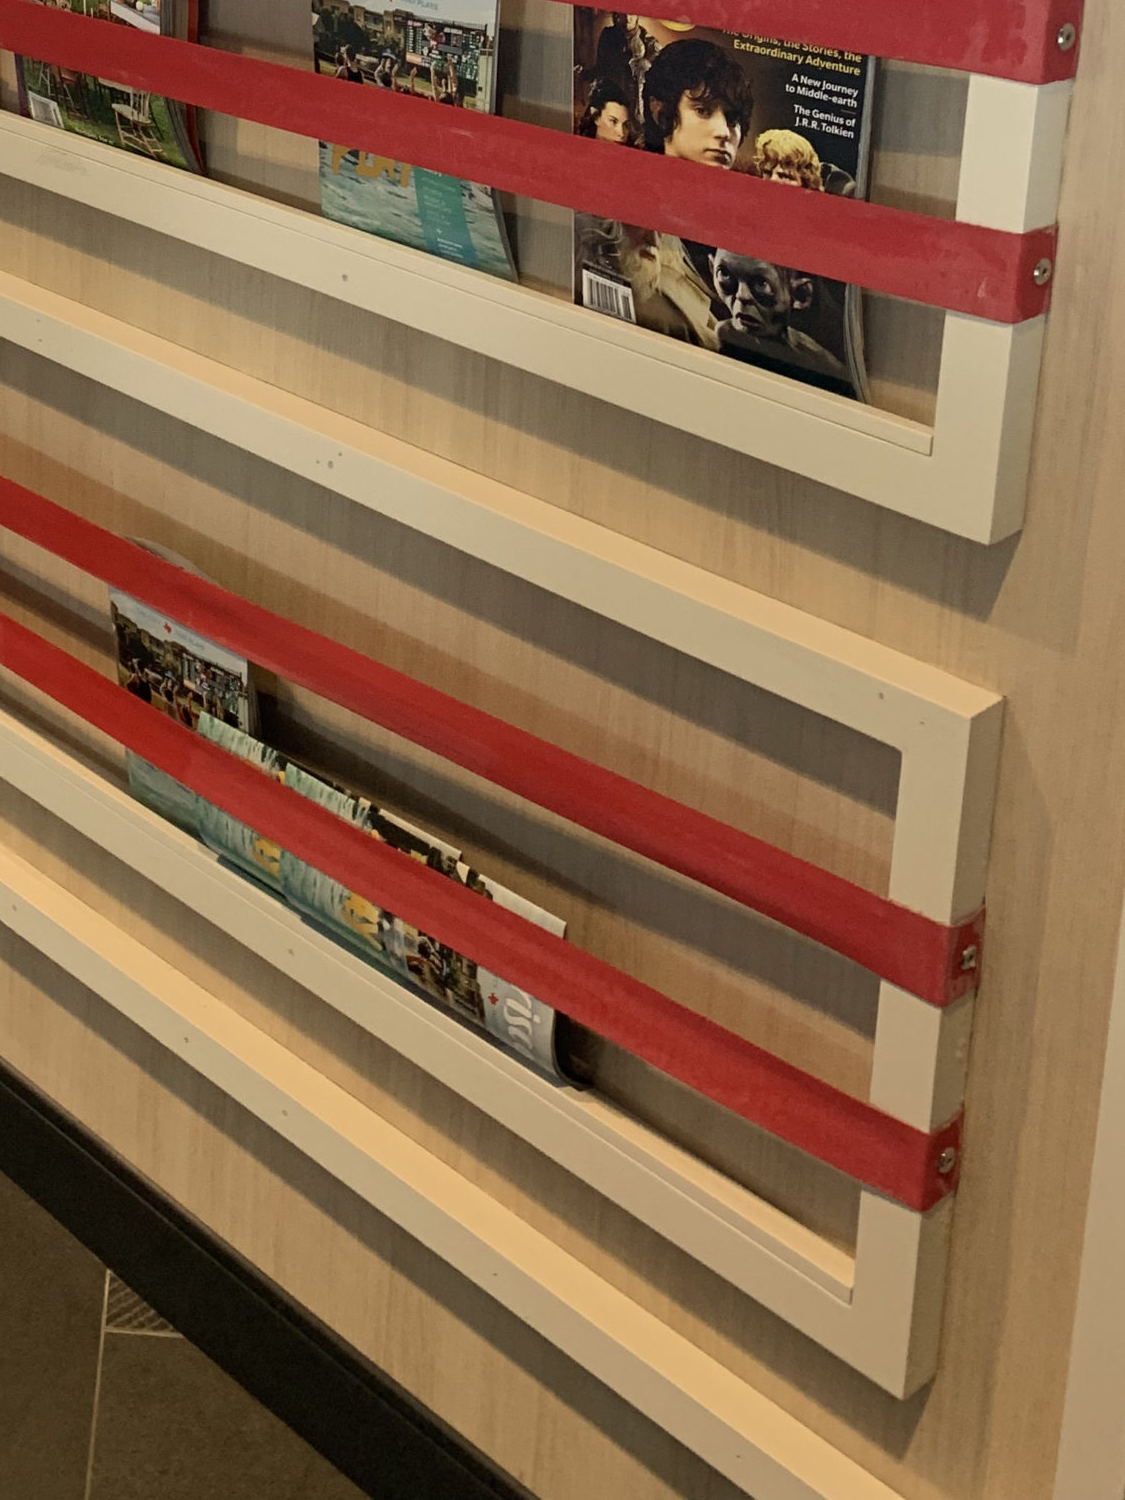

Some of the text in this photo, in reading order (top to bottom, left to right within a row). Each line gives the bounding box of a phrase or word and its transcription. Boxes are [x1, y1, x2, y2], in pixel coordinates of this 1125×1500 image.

[733, 39, 862, 76] Extraordinary Adventure
[844, 50, 863, 64] the
[785, 84, 858, 108] to Middle-earth
[791, 73, 859, 98] A New Journey
[793, 104, 857, 128] The Genius of
[794, 116, 855, 139] J.R.R. Tolkien
